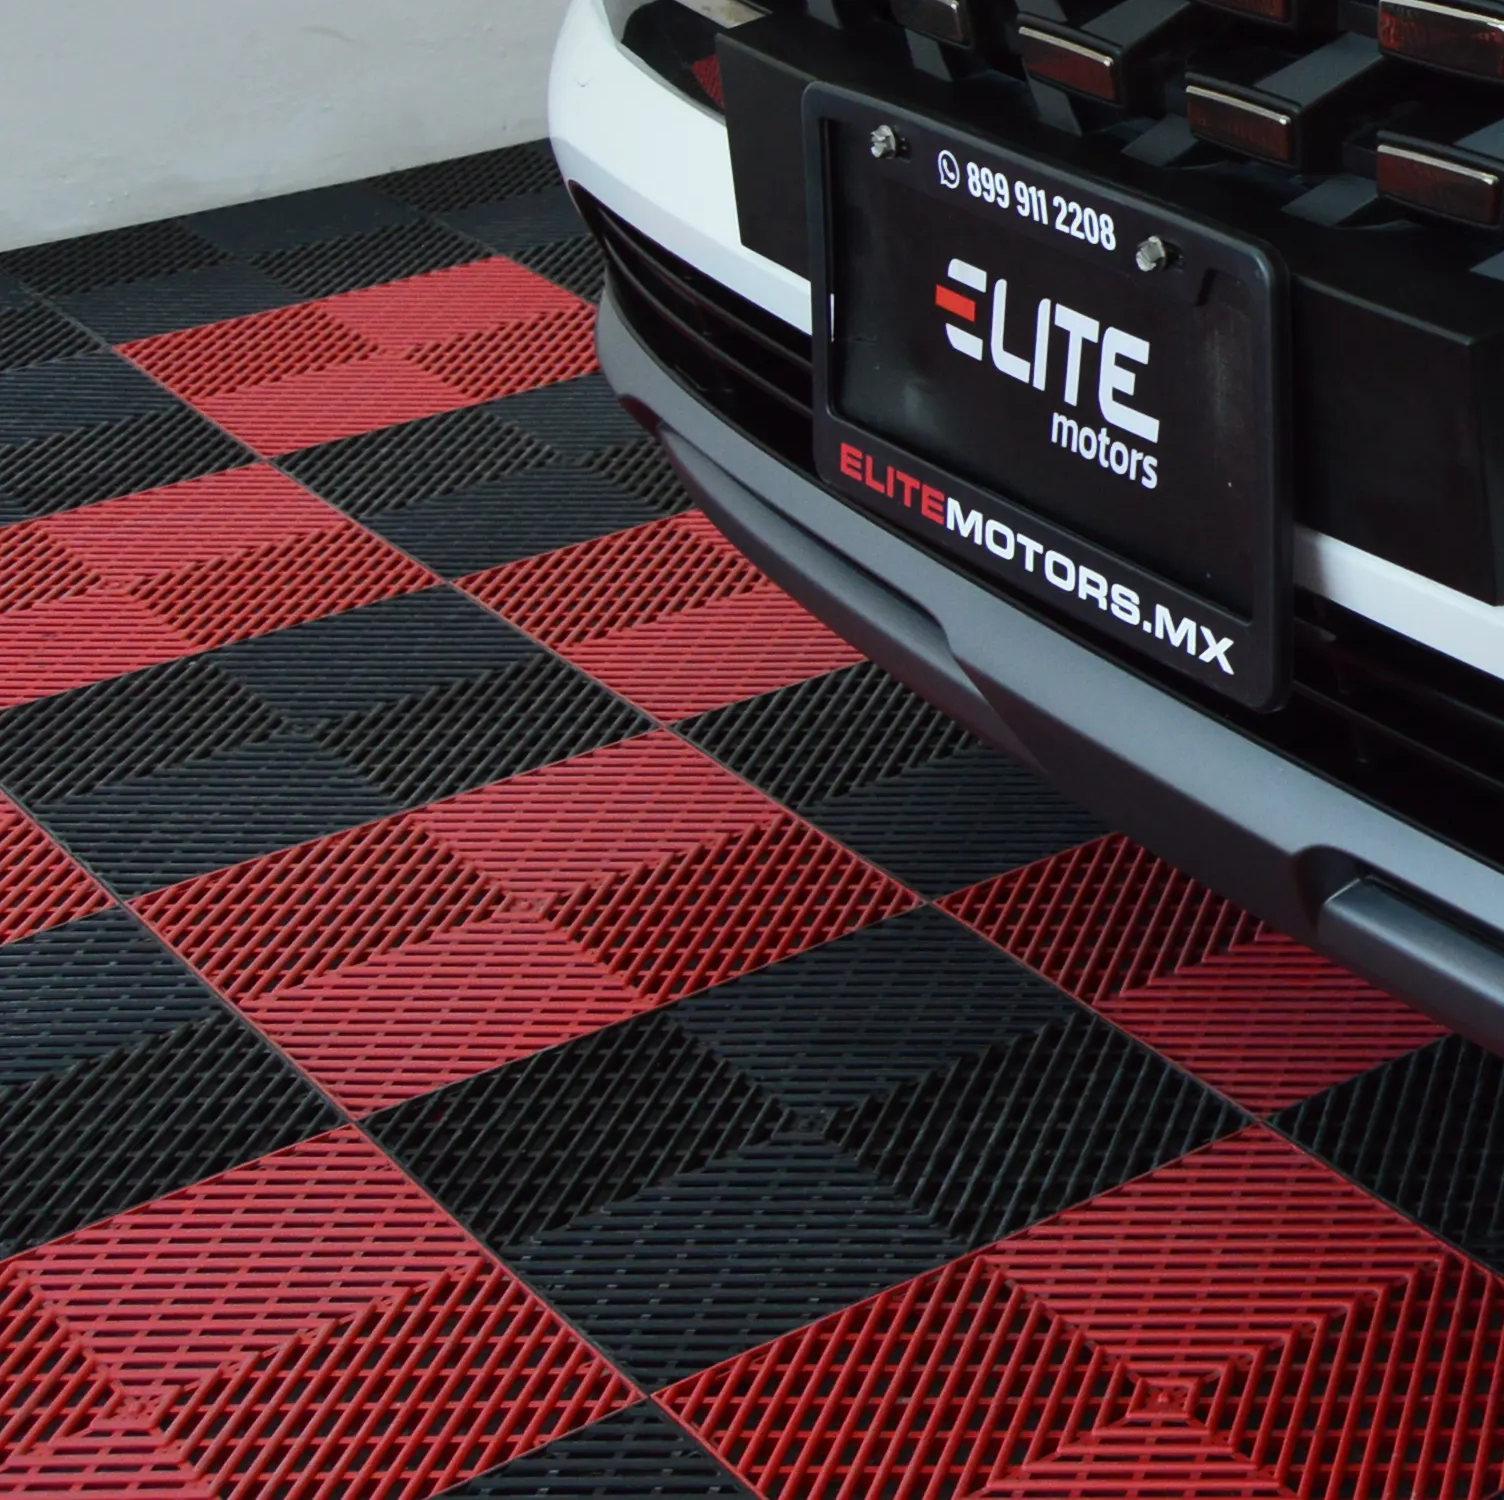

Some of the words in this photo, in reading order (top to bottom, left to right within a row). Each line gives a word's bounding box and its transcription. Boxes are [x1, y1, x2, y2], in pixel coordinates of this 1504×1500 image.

[966, 161, 1010, 209] 899
[1014, 181, 1049, 226] 911
[1053, 195, 1117, 251] 2208
[935, 258, 1160, 444] ELITE
[1050, 411, 1158, 490] motors
[840, 442, 1235, 676] ELITEMOTORS.MX
